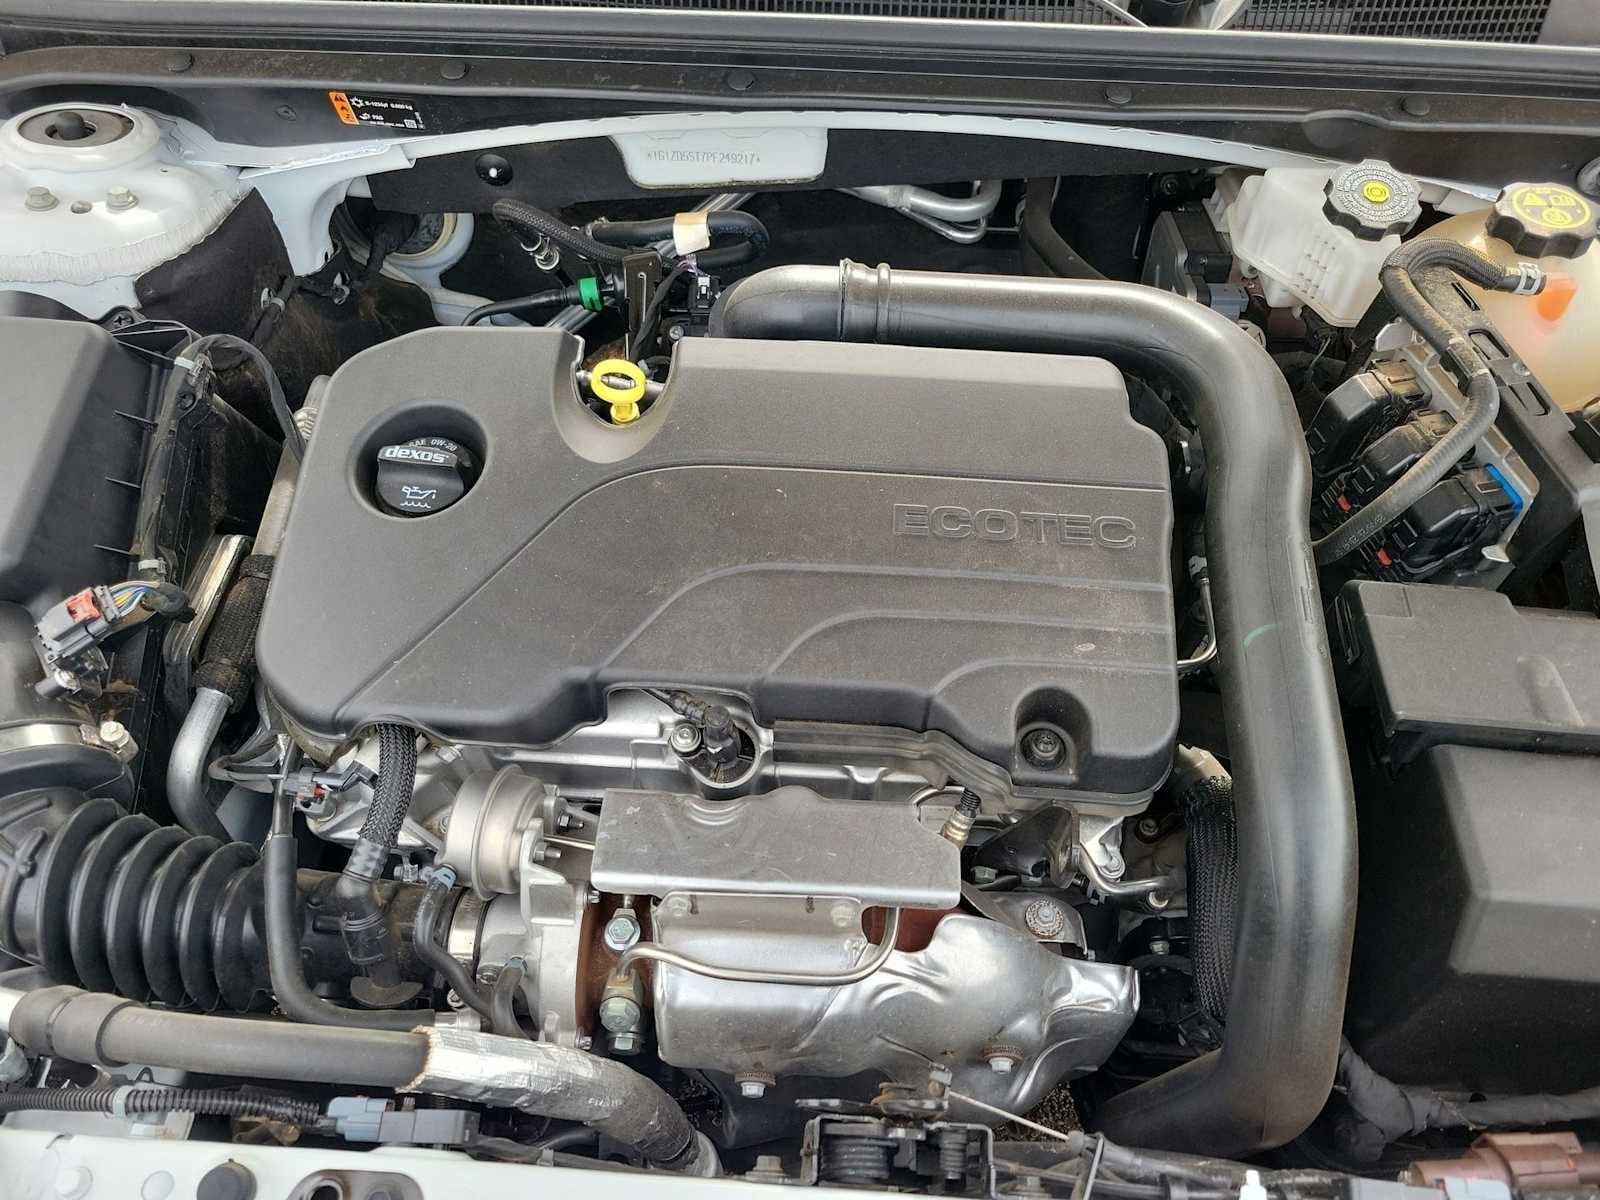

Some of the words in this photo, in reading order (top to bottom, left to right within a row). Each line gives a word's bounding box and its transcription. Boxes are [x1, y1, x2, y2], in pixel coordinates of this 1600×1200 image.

[384, 445, 446, 464] dexos
[430, 438, 458, 452] 0W-20
[893, 503, 1137, 548] ECOTEC
